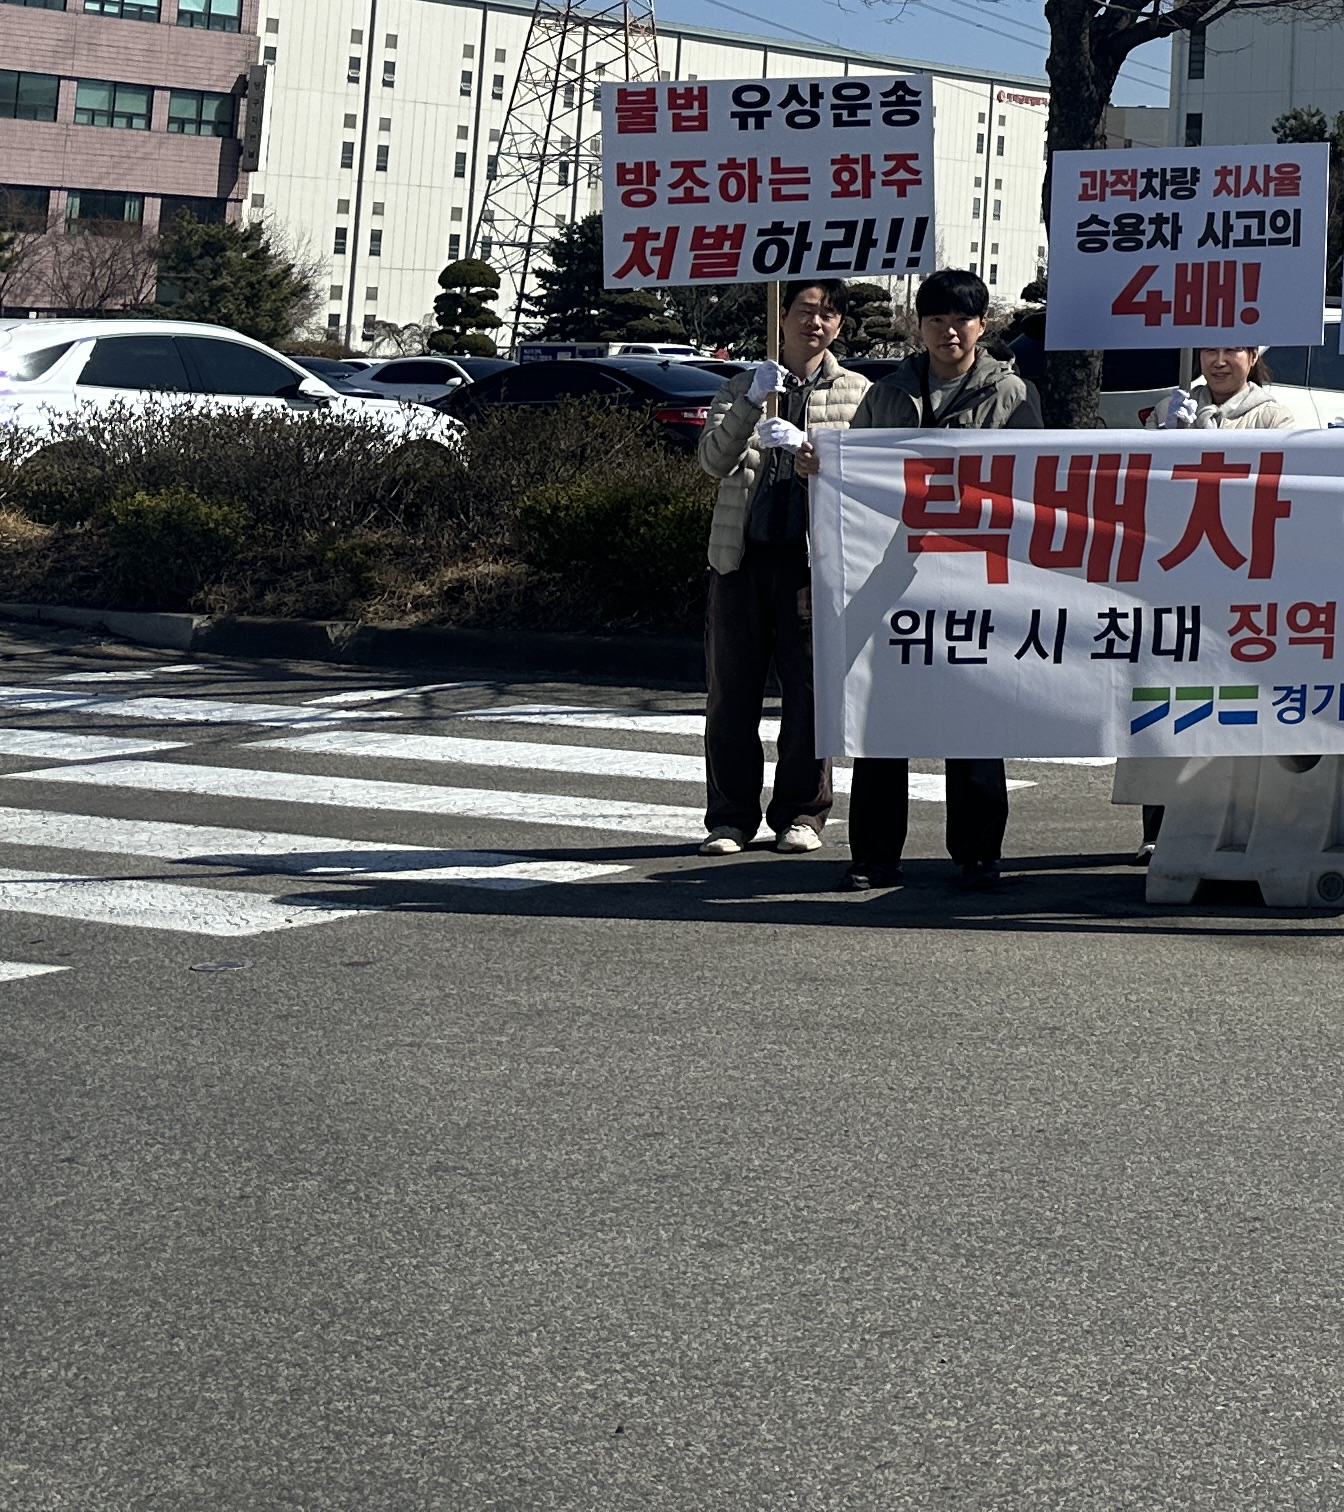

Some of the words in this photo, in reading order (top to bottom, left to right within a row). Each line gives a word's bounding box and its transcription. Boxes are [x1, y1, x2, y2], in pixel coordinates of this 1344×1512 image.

[615, 85, 710, 135] 불법
[729, 80, 923, 132] 유상운송
[615, 155, 811, 209] 방조하는
[830, 152, 923, 200] 화주
[1077, 166, 1201, 203] 과적차량
[1212, 162, 1302, 199] 치사율
[612, 216, 930, 281] 처벌하라!!
[1075, 211, 1183, 254] 승용차
[1197, 207, 1302, 250] 사고의
[1110, 259, 1262, 328] 4배!
[902, 451, 1291, 585] 택배차
[888, 608, 995, 666] 위반
[1013, 607, 1068, 665] 시
[1089, 604, 1202, 666] 최대
[1227, 600, 1336, 663] 징역
